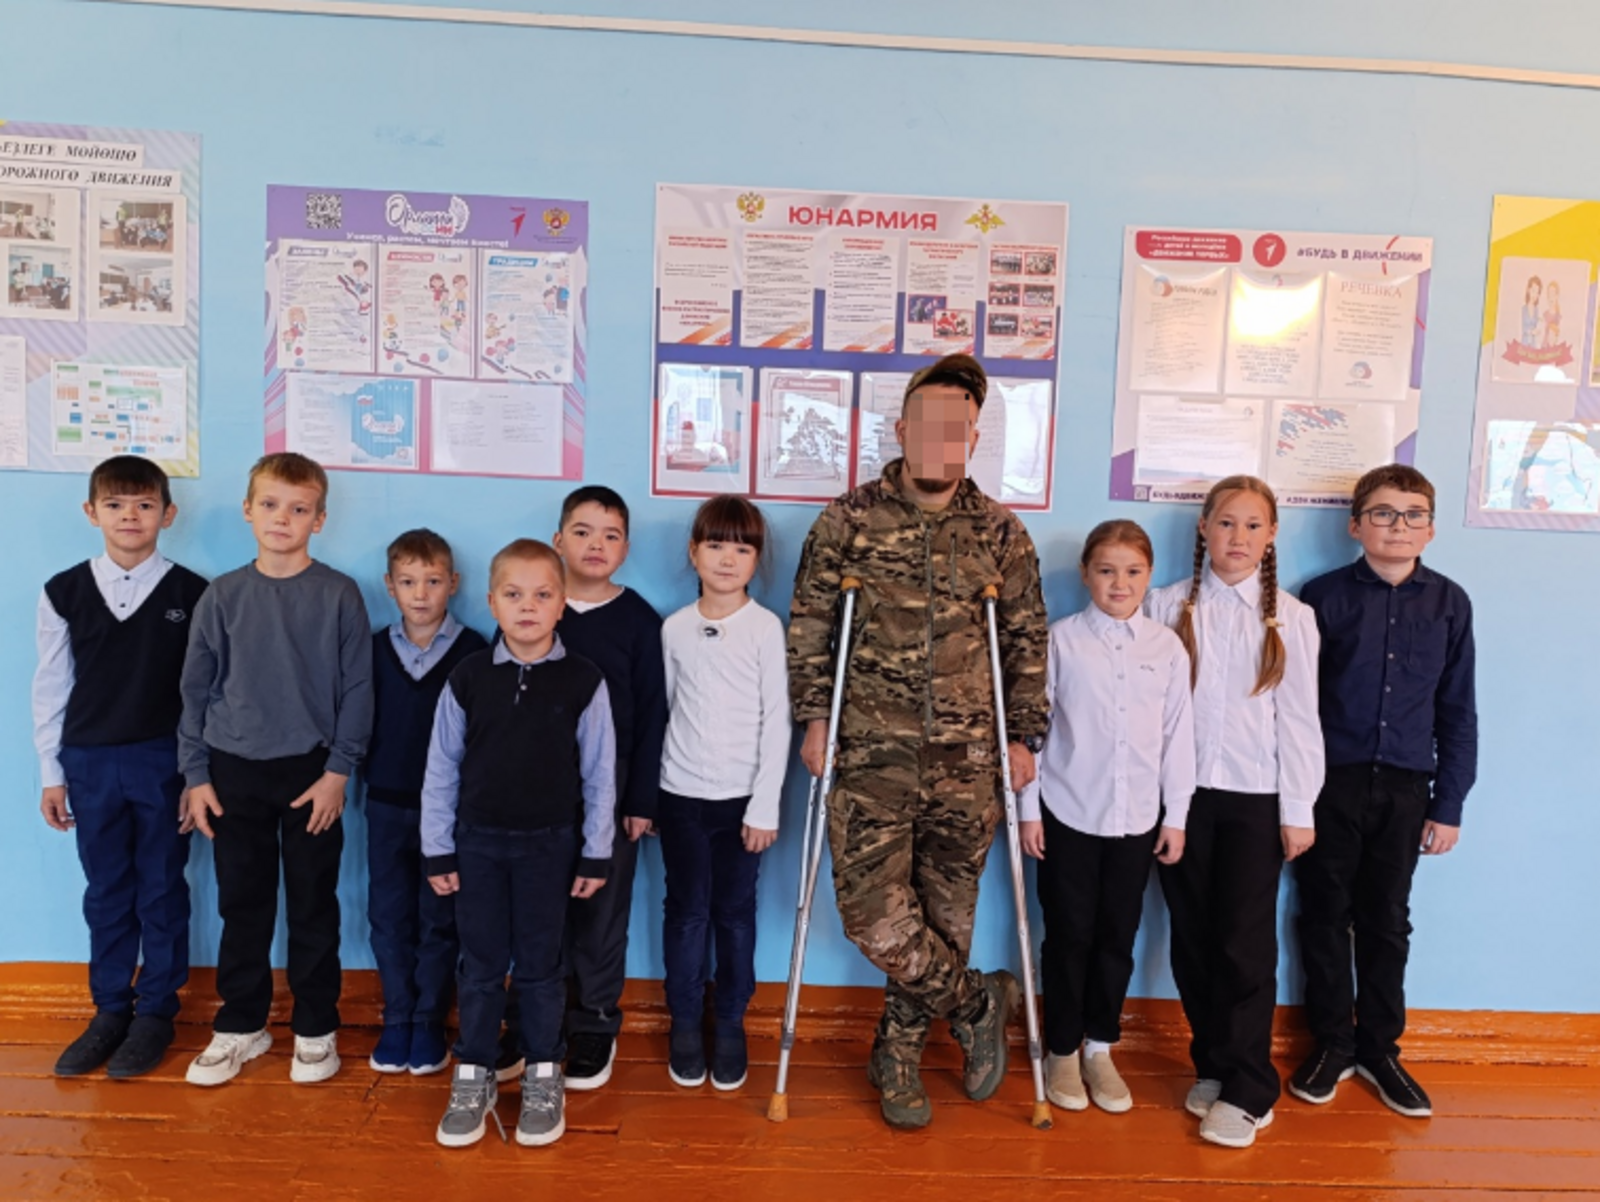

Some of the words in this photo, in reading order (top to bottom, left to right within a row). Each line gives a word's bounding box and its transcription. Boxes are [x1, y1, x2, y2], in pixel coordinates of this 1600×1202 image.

[85, 170, 172, 187] ДВИЖЕНИЯ
[788, 206, 938, 231] ЮНАРМИЯ
[1297, 248, 1337, 259] #БУДЬ
[1341, 249, 1348, 258] В
